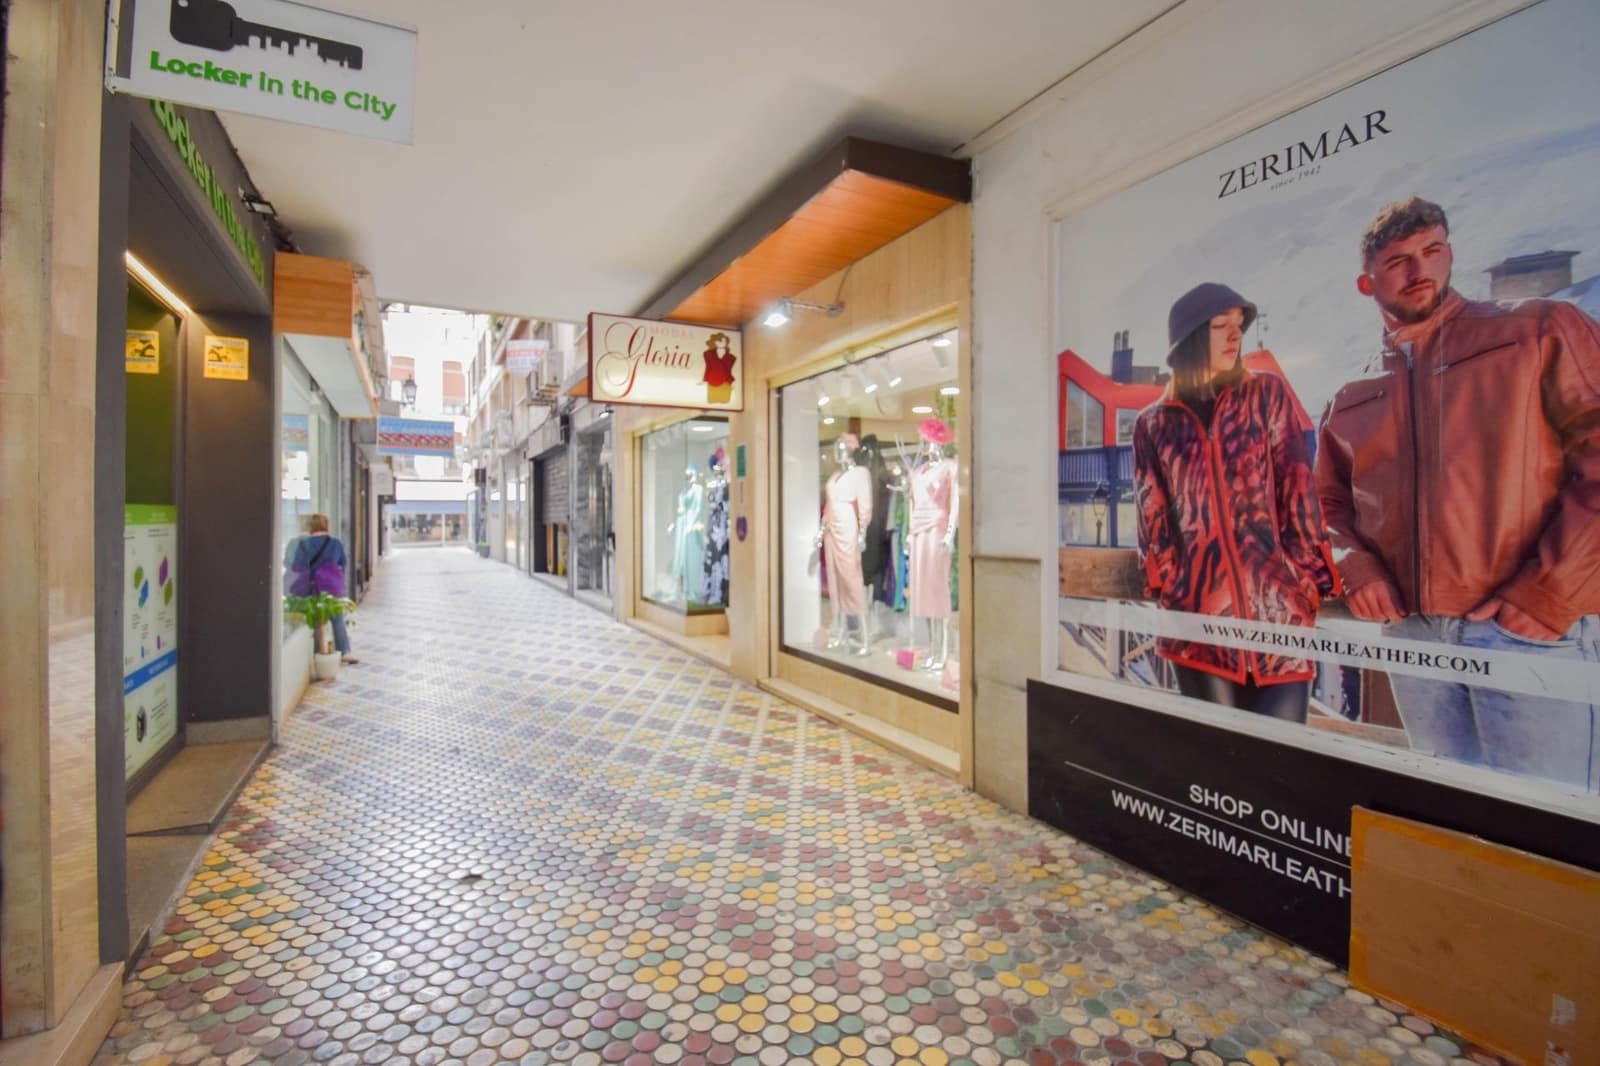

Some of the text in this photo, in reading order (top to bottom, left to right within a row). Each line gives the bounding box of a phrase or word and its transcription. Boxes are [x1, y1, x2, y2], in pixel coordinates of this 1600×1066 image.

[150, 50, 397, 121] Locker in the City
[1218, 109, 1392, 199] ZERIMAR
[596, 321, 693, 399] Gloria
[1189, 784, 1253, 819] SHOP
